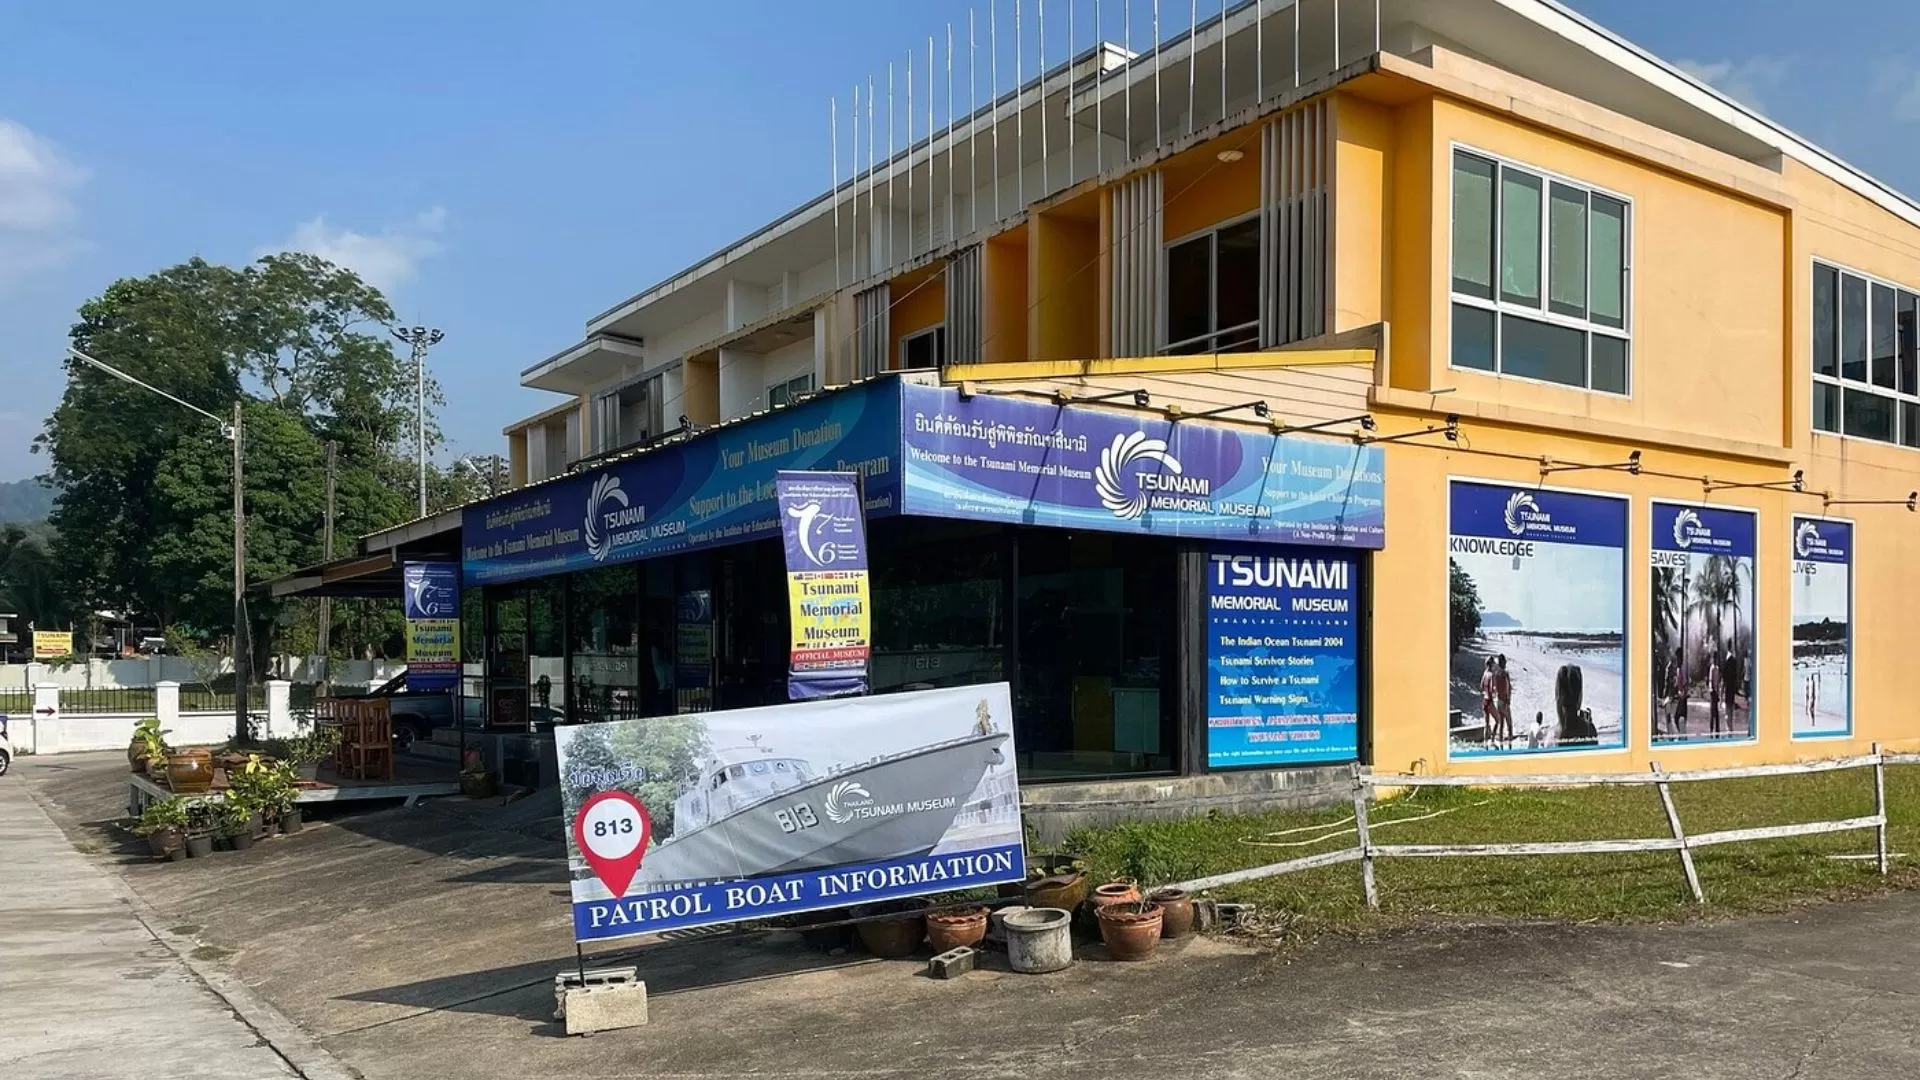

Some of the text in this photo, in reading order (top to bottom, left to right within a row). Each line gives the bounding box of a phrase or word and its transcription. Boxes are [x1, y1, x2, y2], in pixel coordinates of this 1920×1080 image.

[722, 421, 842, 470] Your Museum Donation
[911, 447, 1092, 479] Welcome to the Tsunami Memorial Museum
[1261, 456, 1287, 474] Your
[1291, 460, 1332, 479] Museum
[1135, 473, 1209, 495] TSUNAMI
[689, 491, 724, 520] Support
[727, 489, 736, 508] to
[739, 484, 752, 505] the
[1151, 497, 1271, 517] MEMORIAL MUSEUM
[603, 505, 645, 529] TSUNAMI
[1520, 511, 1550, 522] TSUNAMI
[612, 520, 686, 546] MEMORIAL MUSEUM
[1450, 537, 1534, 557] KNOWLEDGE
[1650, 552, 1686, 566] SAVES
[1211, 554, 1348, 590] TSUNAMI
[801, 581, 859, 595] Tsunami
[800, 602, 862, 617] Memorial
[1212, 596, 1348, 612] MEMORIAL MUSEUM
[804, 627, 860, 640] Museum
[1220, 636, 1343, 647] The Indian Ocean Tsunami 2004
[795, 649, 865, 660] OFFICIAL MUSEUM
[1220, 656, 1314, 665] Tsunami Survivor Stories
[1220, 676, 1237, 685] How
[1240, 676, 1249, 685] to
[1251, 676, 1279, 685] Survive
[1289, 675, 1319, 685] Tsunami
[1219, 695, 1308, 706] Tsunami Warning Signs
[843, 798, 874, 808] THAILAND
[853, 797, 956, 819] TSUNAMI MUSEUM
[594, 818, 633, 837] 813
[774, 802, 819, 834] 813
[590, 851, 1013, 928] PATROL BOAT INFORMATION
